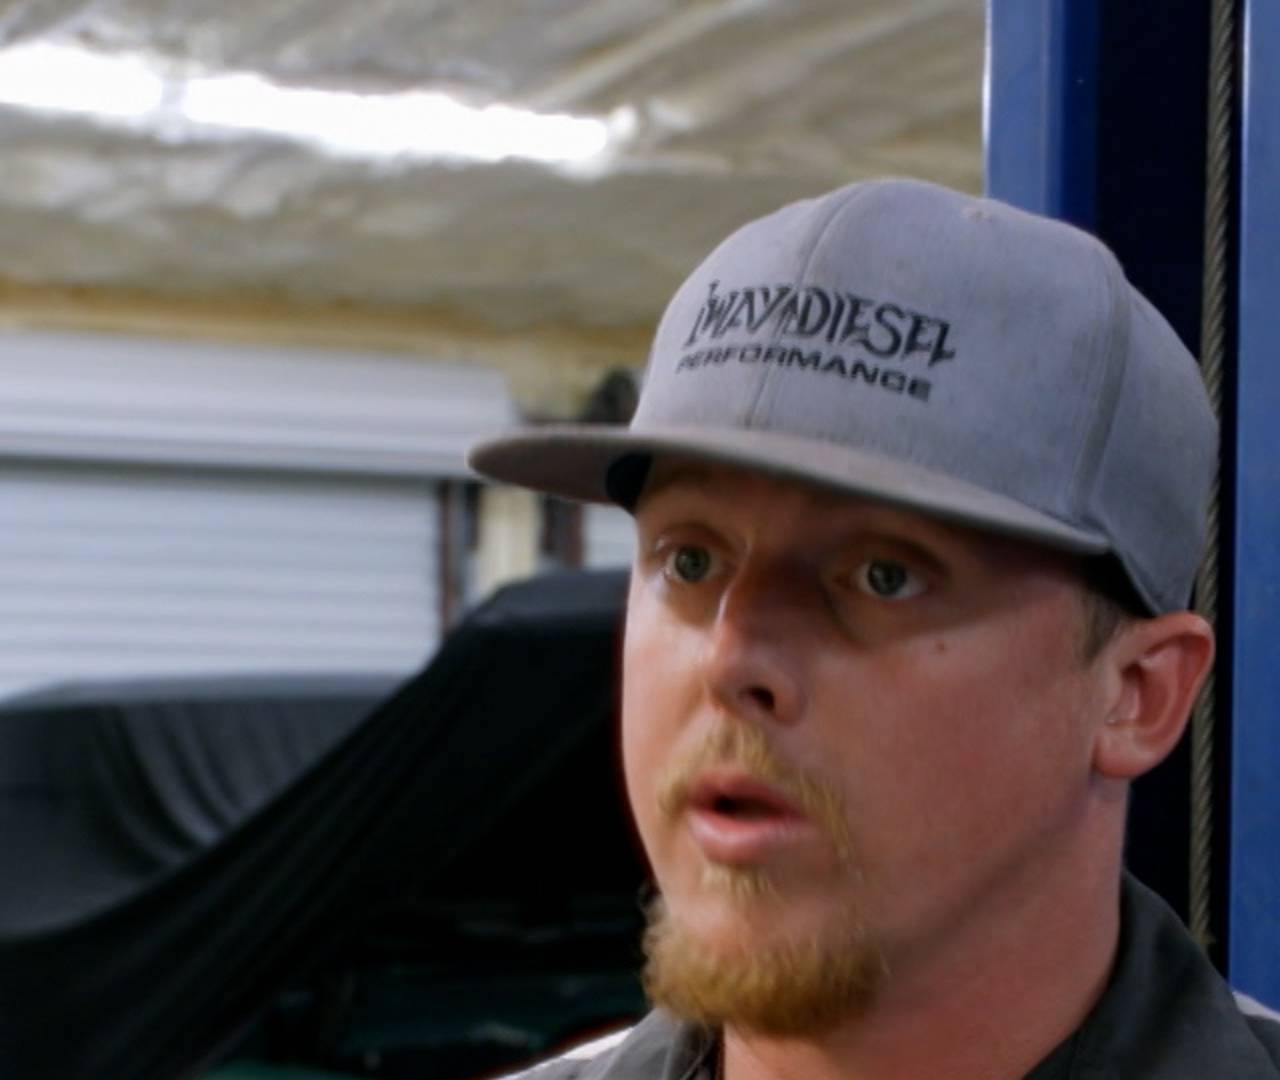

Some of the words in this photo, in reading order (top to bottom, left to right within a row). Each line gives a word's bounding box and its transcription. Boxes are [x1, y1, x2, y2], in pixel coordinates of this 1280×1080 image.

[699, 285, 794, 342] WAY
[790, 286, 956, 367] DIESEL
[675, 342, 932, 403] PERFORMANCE
